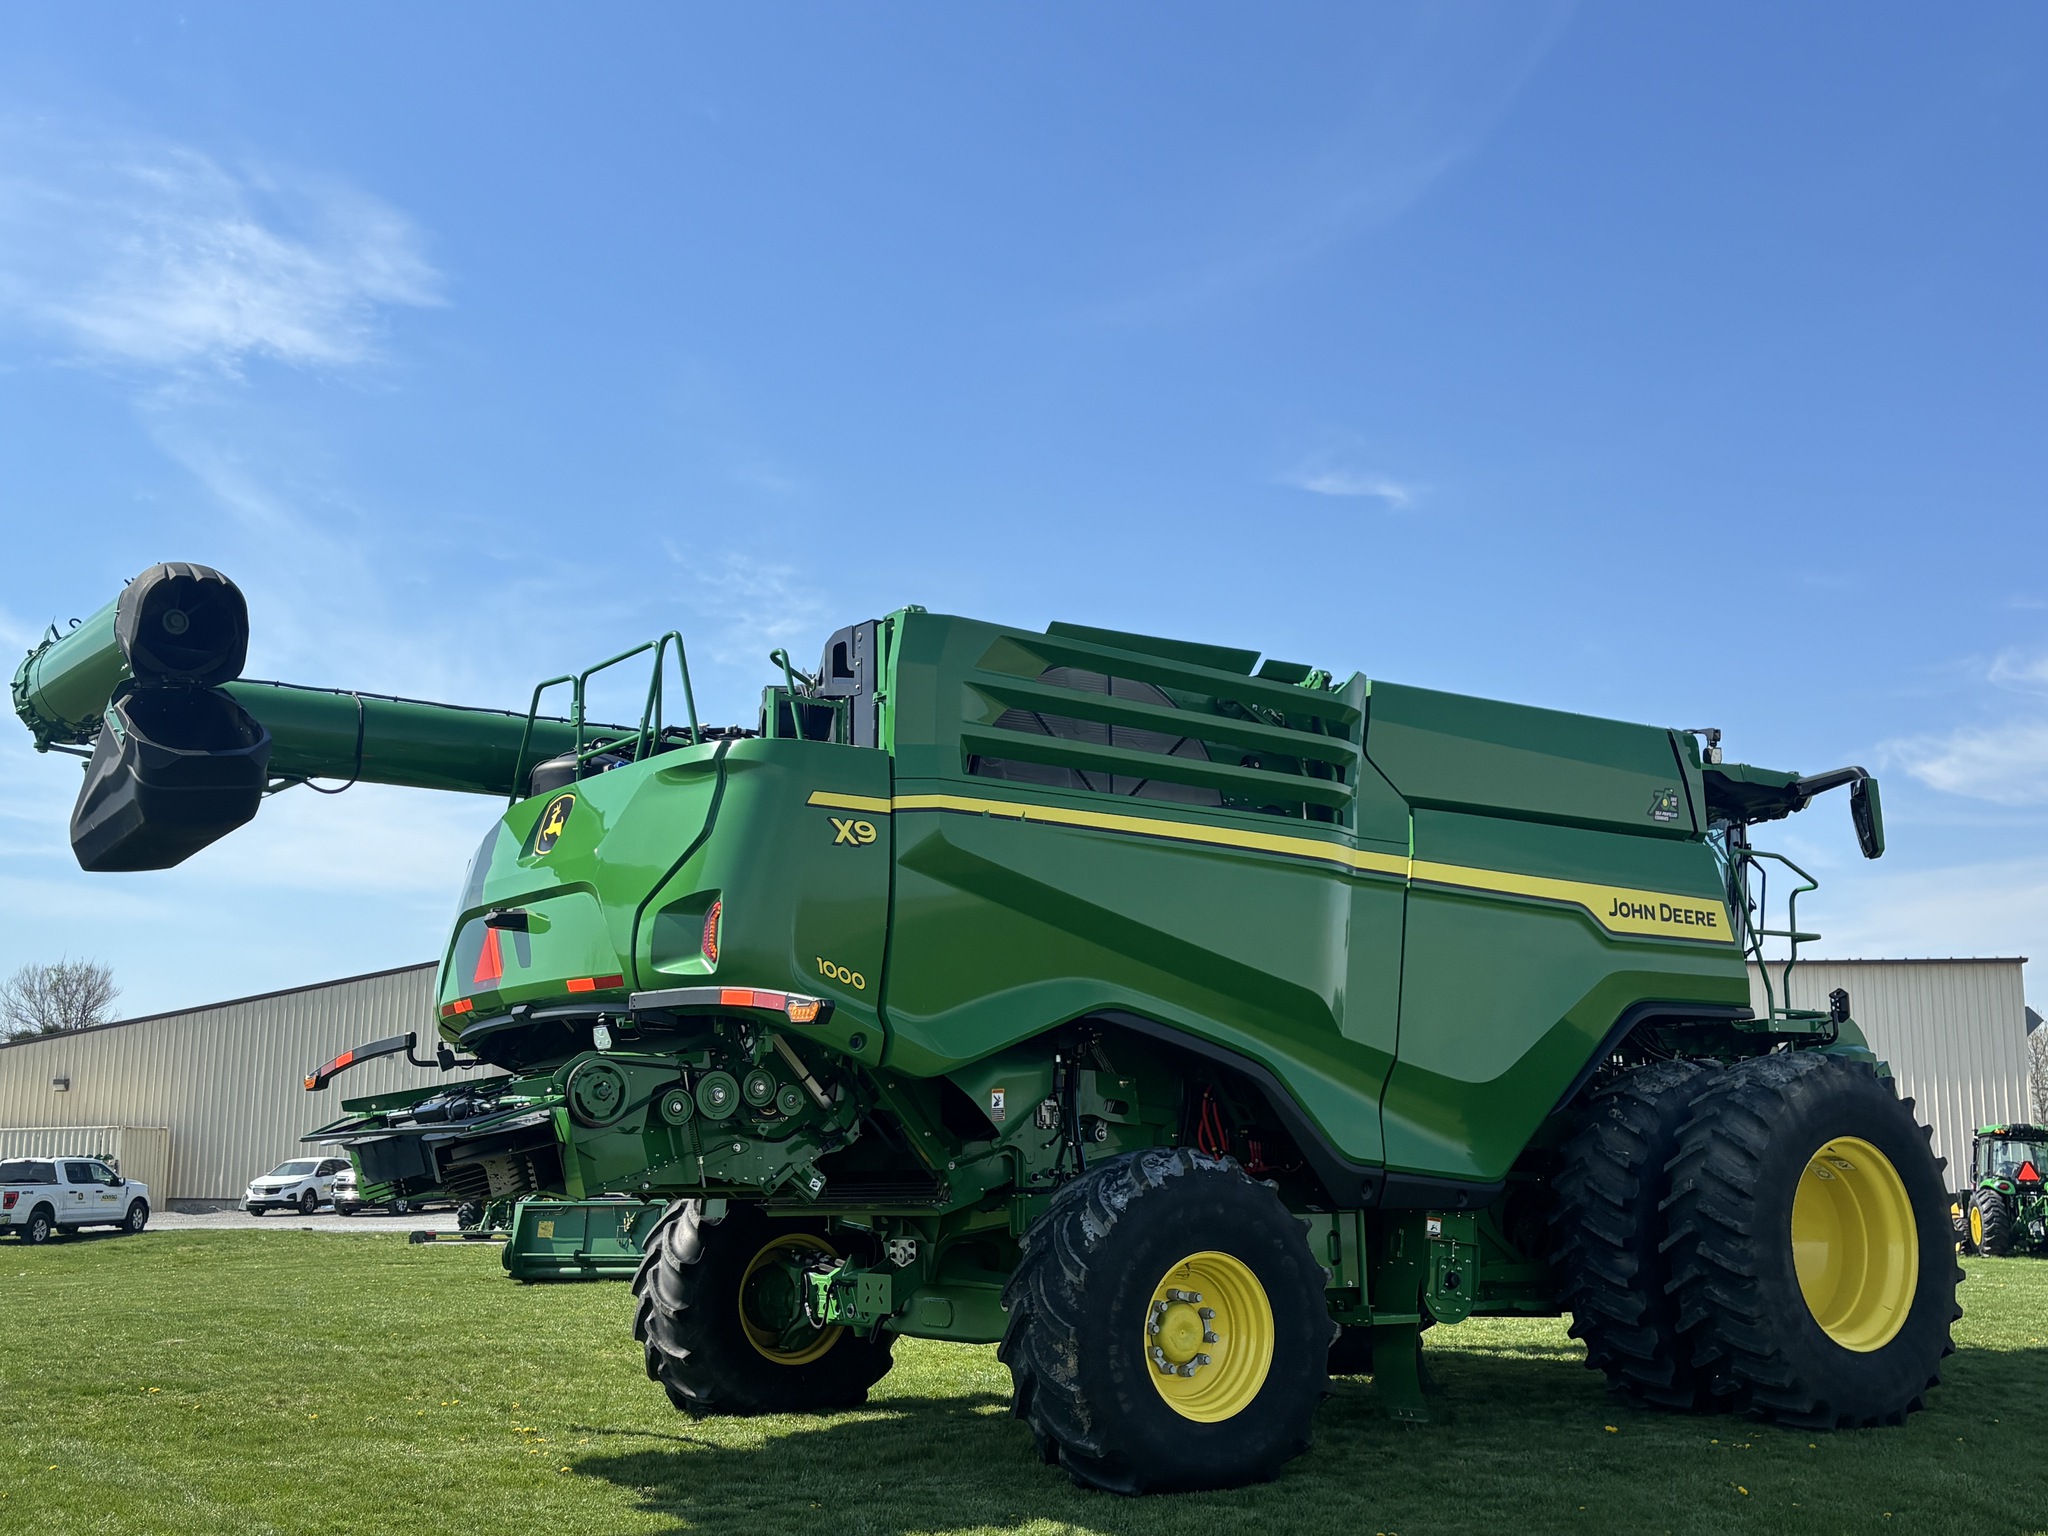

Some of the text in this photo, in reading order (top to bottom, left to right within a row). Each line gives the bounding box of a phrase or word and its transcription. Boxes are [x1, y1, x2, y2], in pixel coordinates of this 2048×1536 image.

[828, 817, 877, 847] X9
[1609, 898, 1717, 927] JOHN DEERE
[816, 956, 866, 990] 1000
